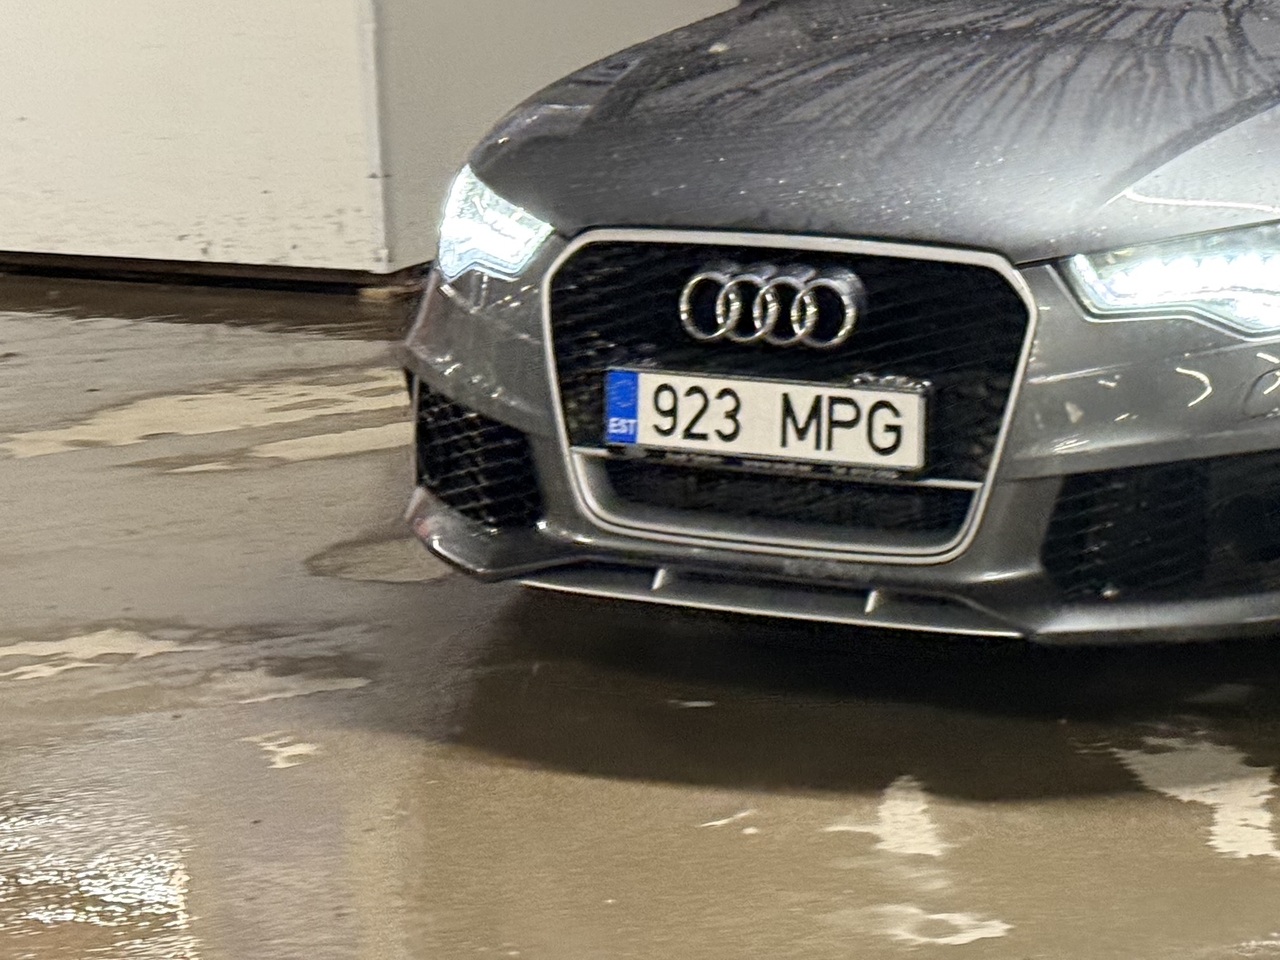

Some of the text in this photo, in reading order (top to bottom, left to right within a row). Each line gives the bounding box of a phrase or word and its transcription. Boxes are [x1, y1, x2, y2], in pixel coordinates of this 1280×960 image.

[608, 417, 637, 435] EST
[653, 383, 903, 456] 923 MPG
